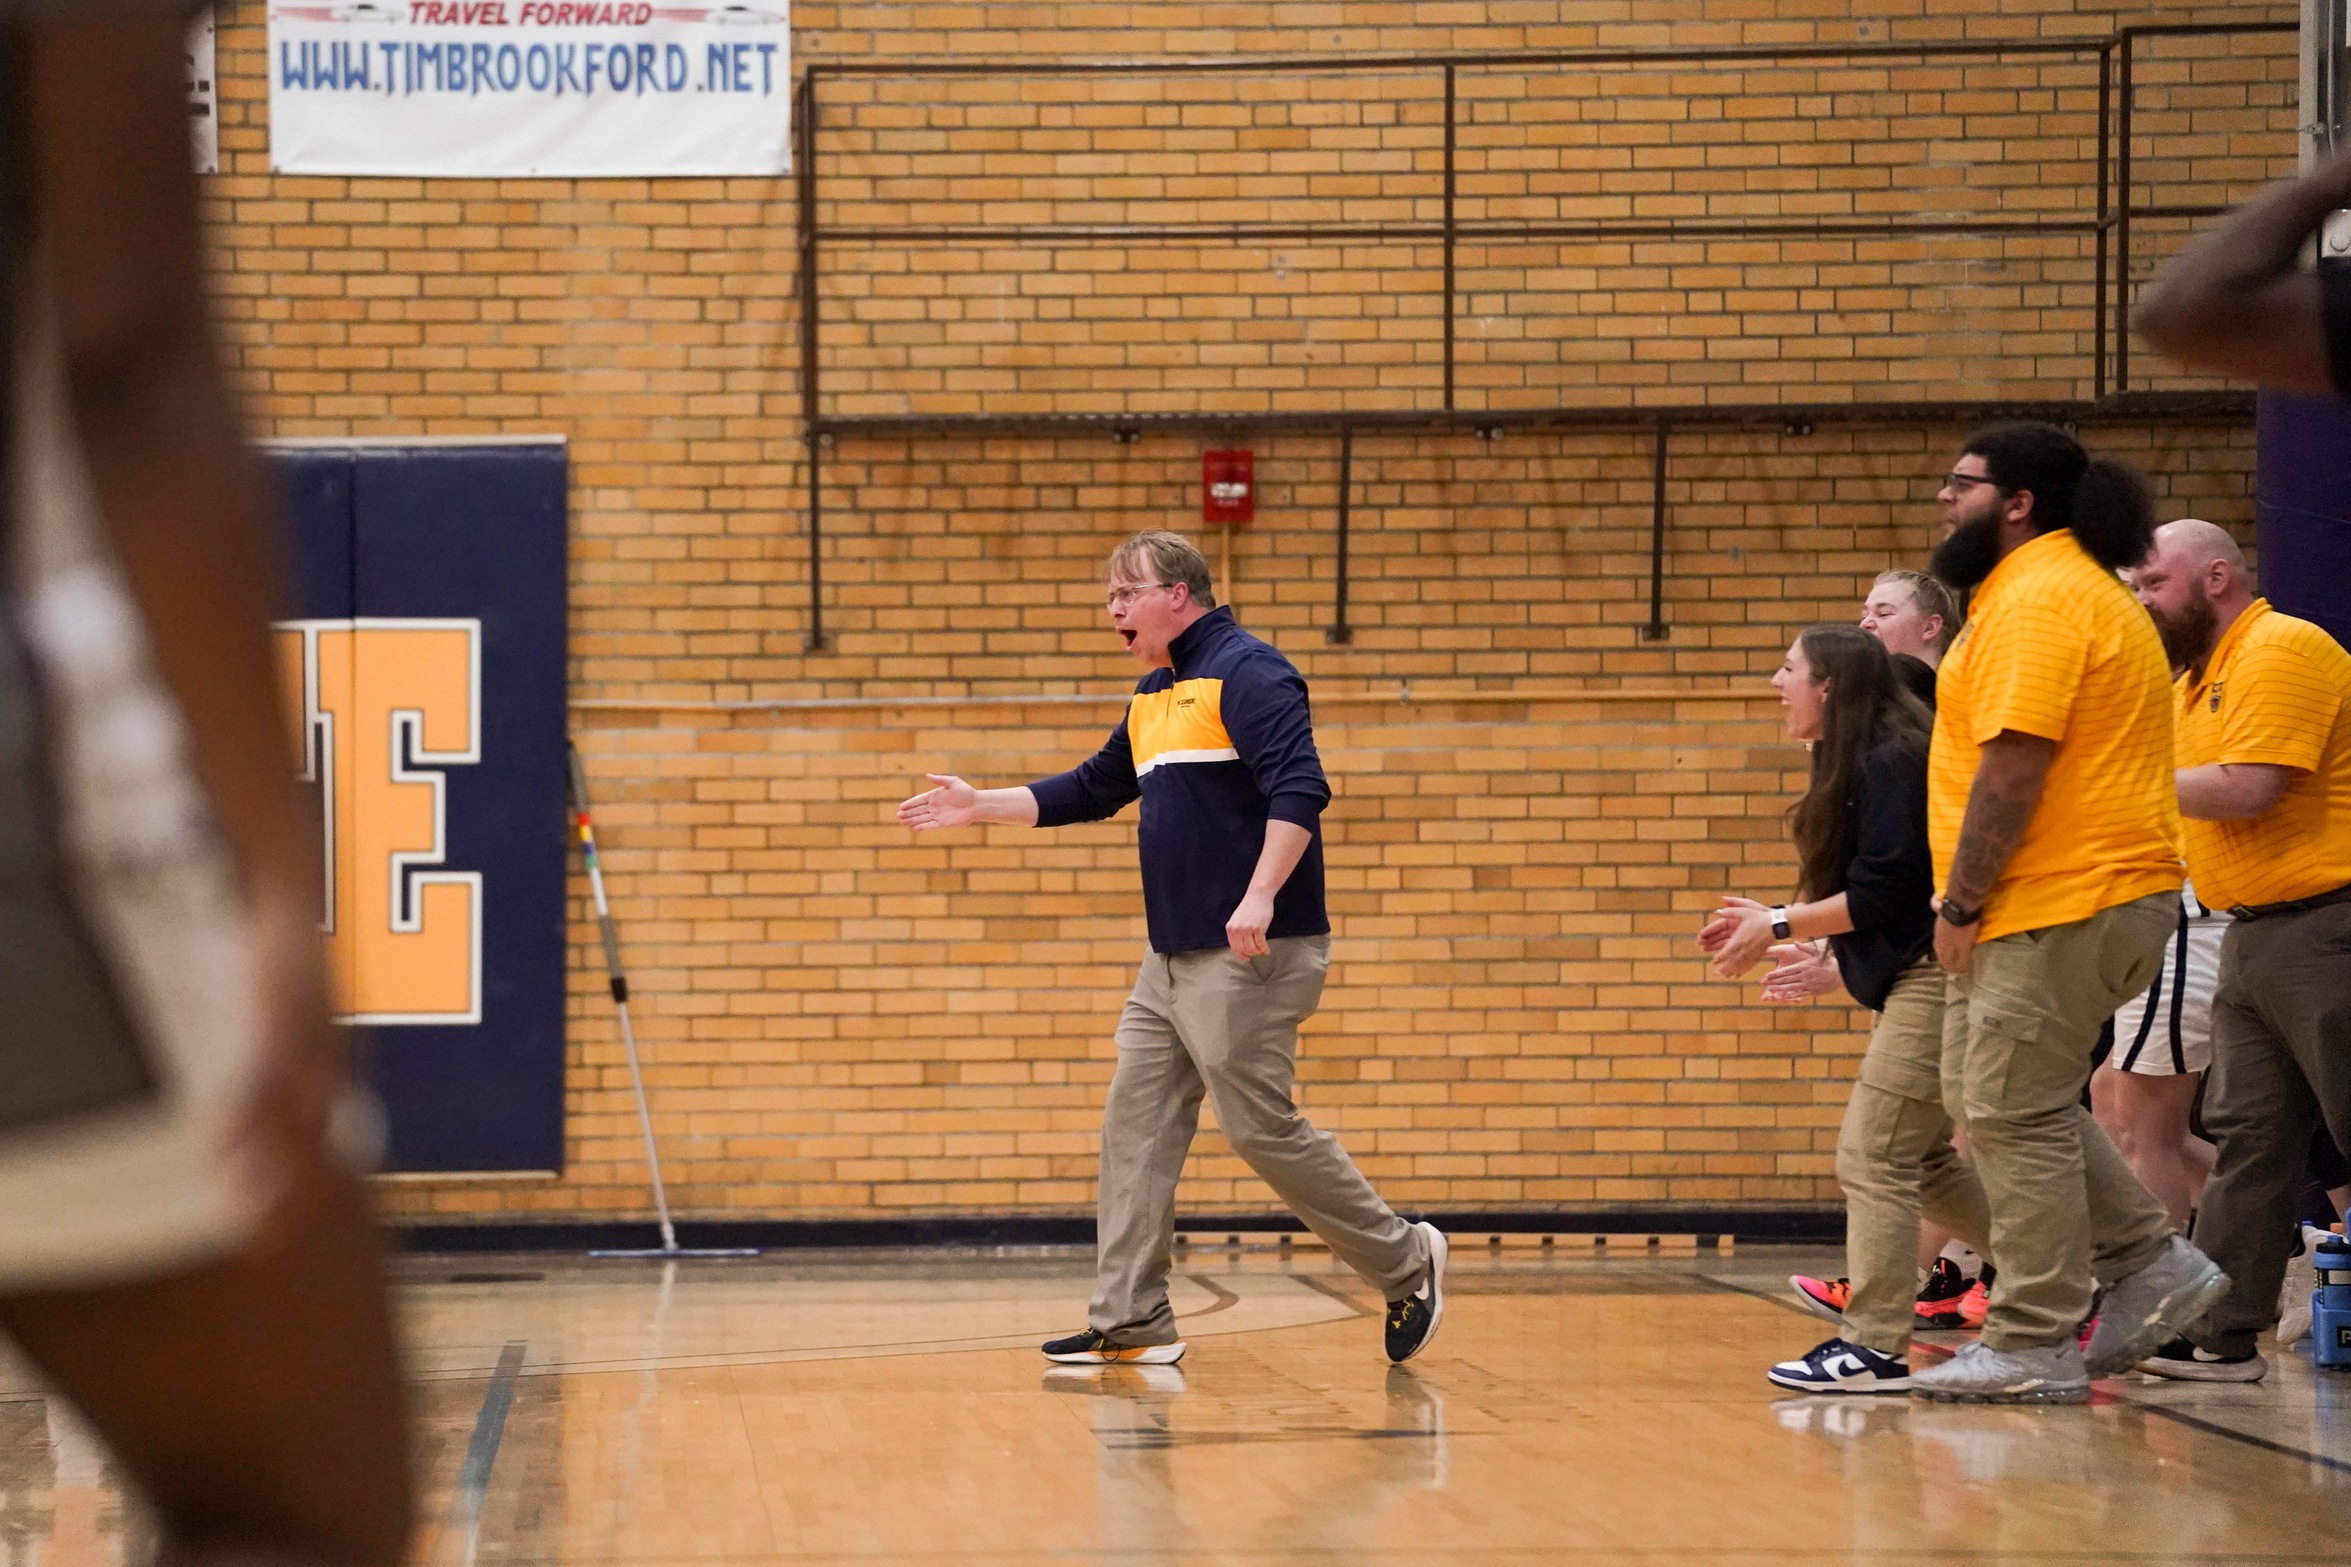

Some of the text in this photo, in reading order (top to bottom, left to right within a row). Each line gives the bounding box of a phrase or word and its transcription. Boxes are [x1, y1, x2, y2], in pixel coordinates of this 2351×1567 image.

[409, 1, 653, 25] TRAVEL FORWARD
[282, 40, 777, 97] WWW.TIMBROOKFORD.NET
[272, 617, 482, 1025] E
